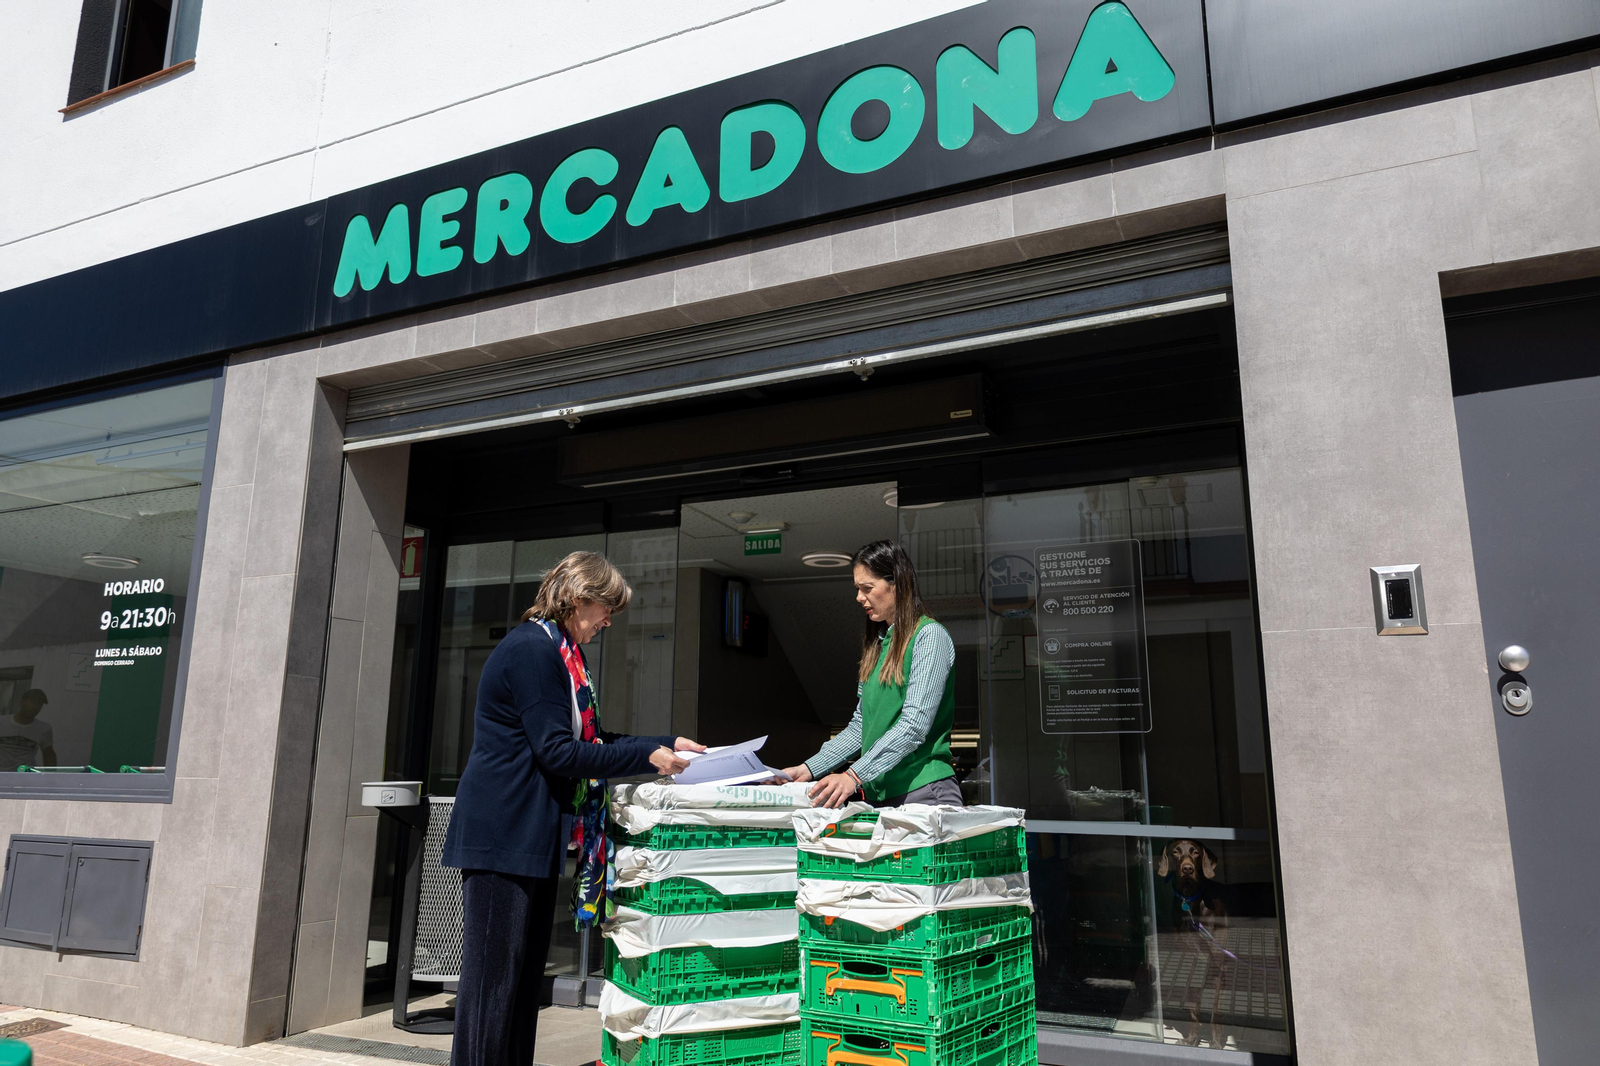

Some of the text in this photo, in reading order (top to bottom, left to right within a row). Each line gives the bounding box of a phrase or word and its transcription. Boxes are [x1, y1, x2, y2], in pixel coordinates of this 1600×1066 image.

[333, 1, 1177, 299] MERCADONA
[745, 539, 781, 550] SALIDA
[1040, 550, 1086, 562] GESTIONE
[1040, 557, 1111, 570] SUS SERVICIOS
[1040, 566, 1102, 578] A TRAVÉS DE
[103, 578, 165, 596] HORARIO
[1040, 578, 1101, 588] www.mercadona.es
[1062, 606, 1114, 616] 800 500 220
[95, 645, 162, 658] LUNES A SÁBADO
